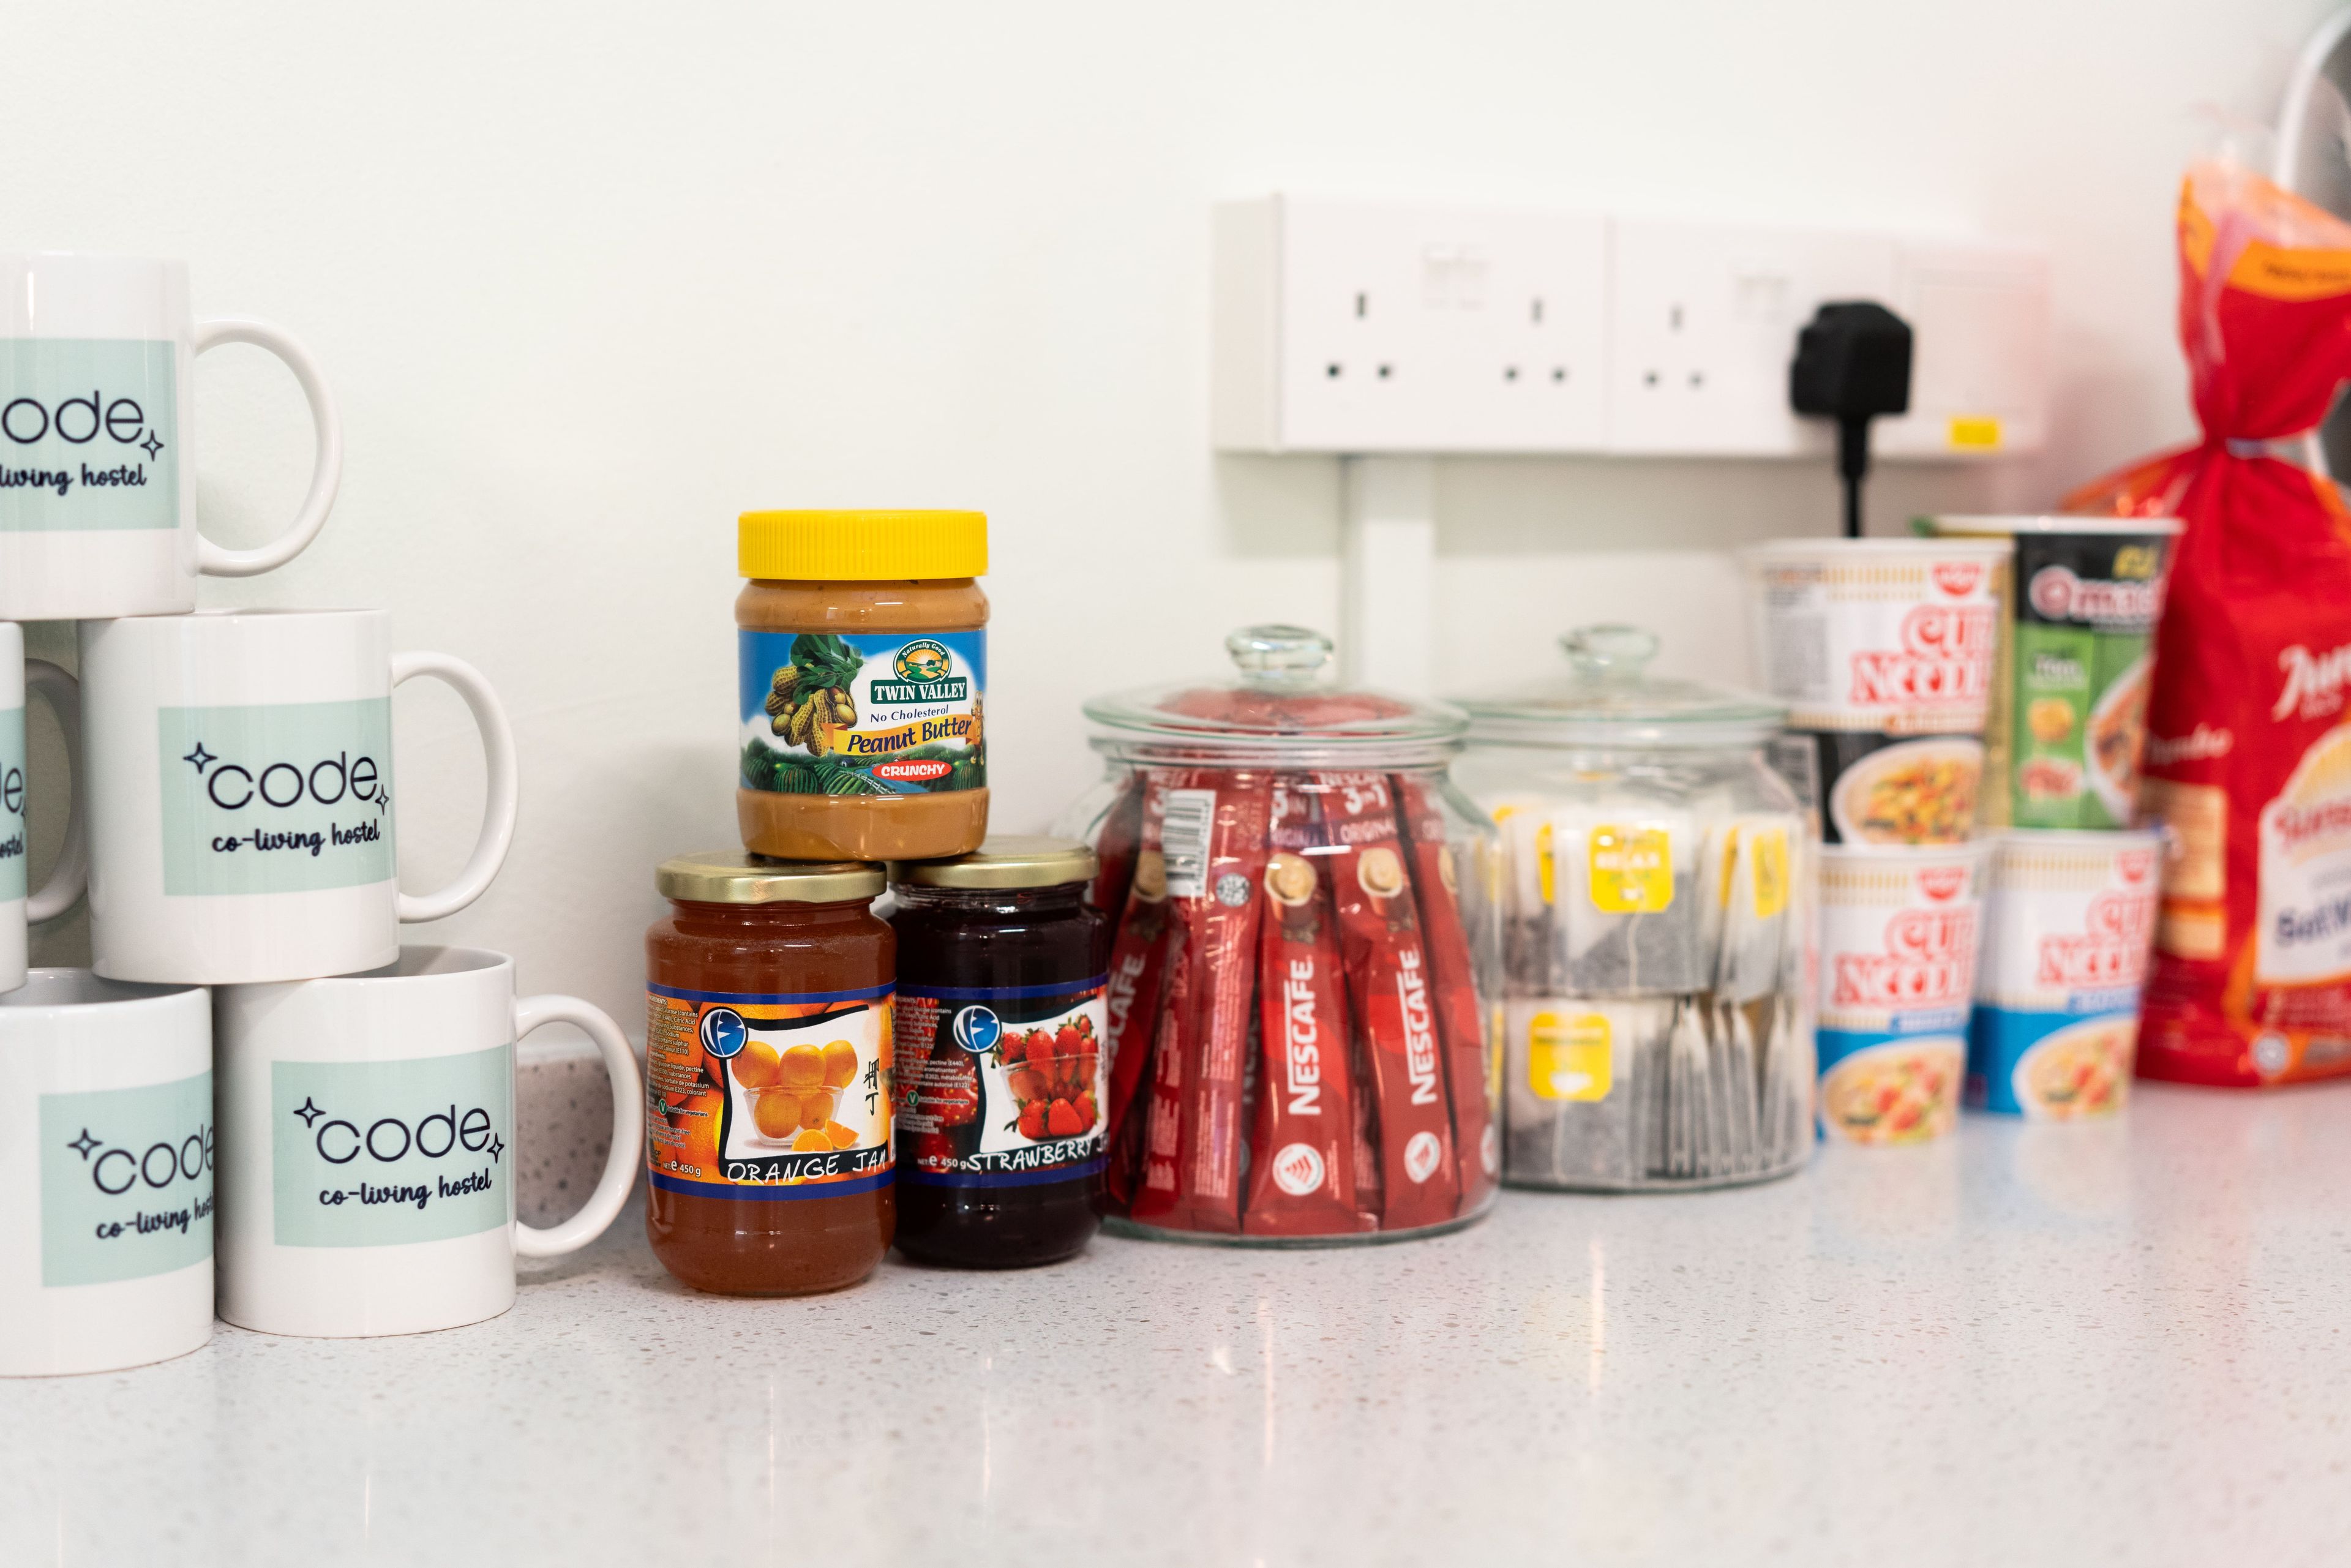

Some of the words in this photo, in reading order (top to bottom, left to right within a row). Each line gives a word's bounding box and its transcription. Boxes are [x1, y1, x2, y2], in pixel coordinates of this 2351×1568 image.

[81, 462, 148, 487] hostel
[902, 642, 931, 658] Naturally
[931, 643, 946, 656] Good
[874, 685, 916, 701] TWIN
[919, 681, 966, 700] VALLEY
[870, 713, 887, 723] No
[891, 705, 949, 722] Cholesterol
[847, 727, 917, 754] Peanut
[921, 715, 972, 742] Butter
[880, 761, 947, 777] CRUNCHY
[208, 751, 378, 811] code
[211, 828, 326, 857] co-living
[331, 818, 381, 846] hostel
[669, 1023, 694, 1033] Substances,
[675, 1047, 689, 1056] (E110)
[669, 1071, 691, 1079] substances
[316, 1104, 491, 1165] code
[940, 1158, 958, 1168] 450
[960, 1160, 967, 1170] g
[967, 1138, 1093, 1171] STRAWBERRY
[680, 1164, 694, 1174] 450
[695, 1168, 701, 1177] g
[727, 1154, 841, 1186] ORANGE
[852, 1149, 886, 1174] JAM
[319, 1182, 433, 1210] co-living
[438, 1167, 492, 1198] hostel
[96, 1209, 192, 1239] co-living
